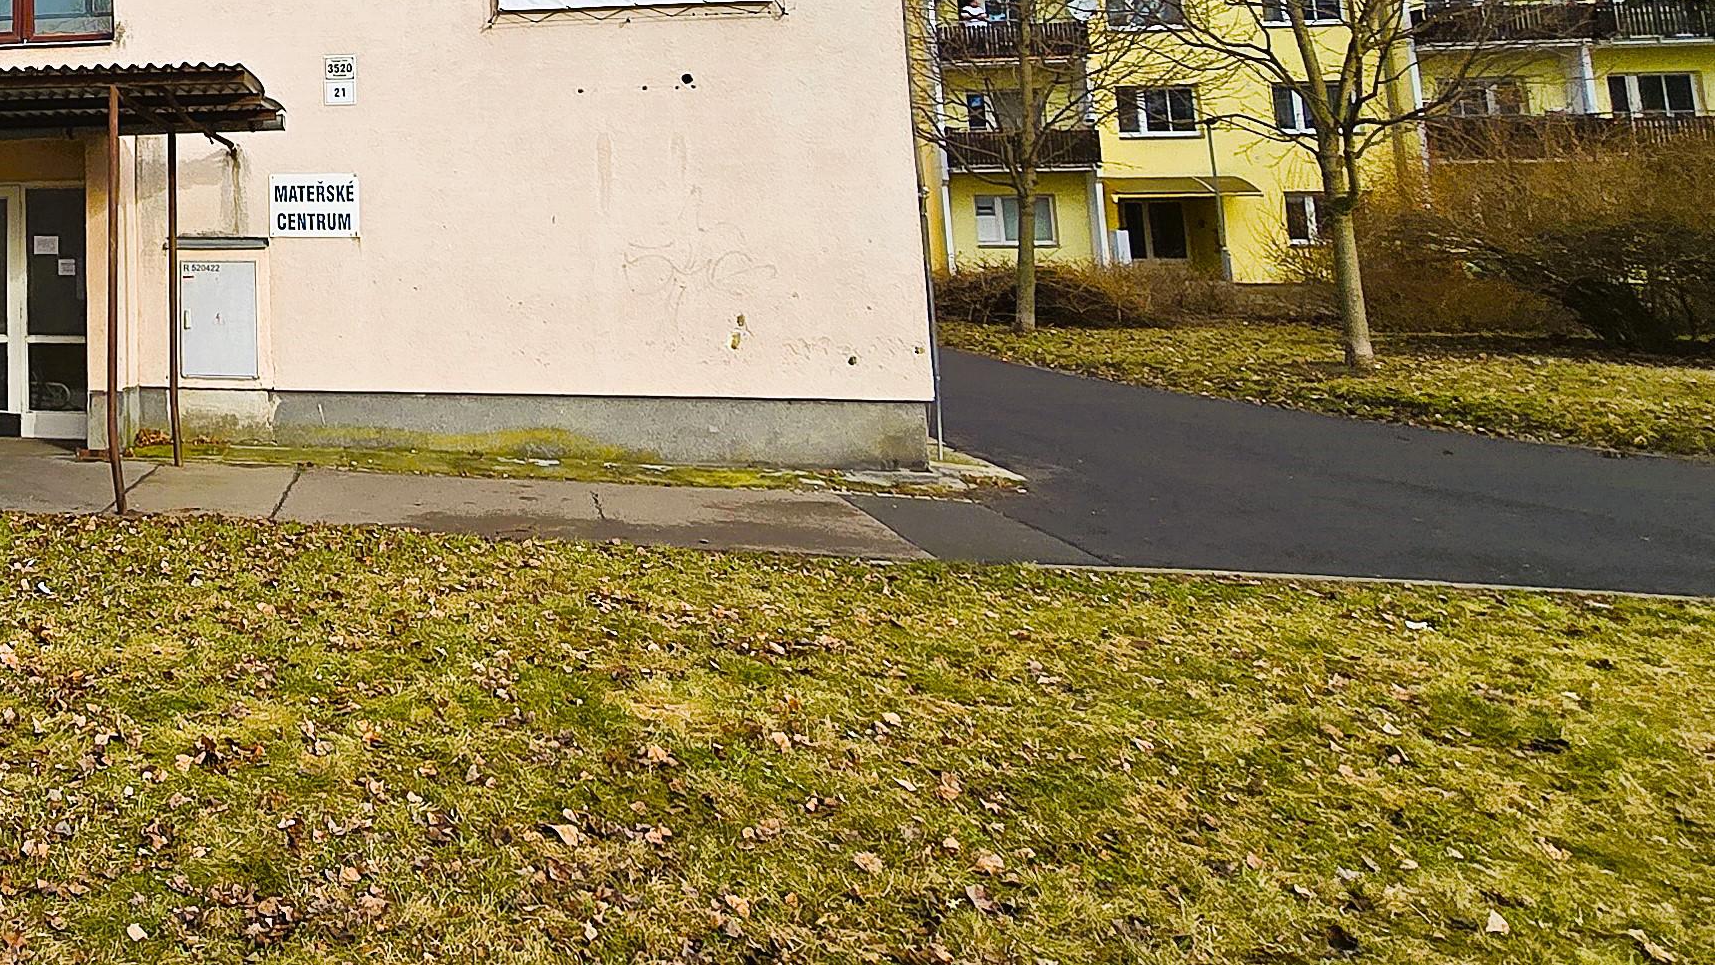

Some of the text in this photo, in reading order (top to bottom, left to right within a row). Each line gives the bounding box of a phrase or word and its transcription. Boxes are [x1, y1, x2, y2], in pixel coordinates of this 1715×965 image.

[327, 63, 353, 73] 3520
[334, 87, 346, 98] 21
[274, 180, 354, 203] MATEŘSKÉ
[277, 212, 351, 231] CENTRUM
[183, 264, 190, 272] R
